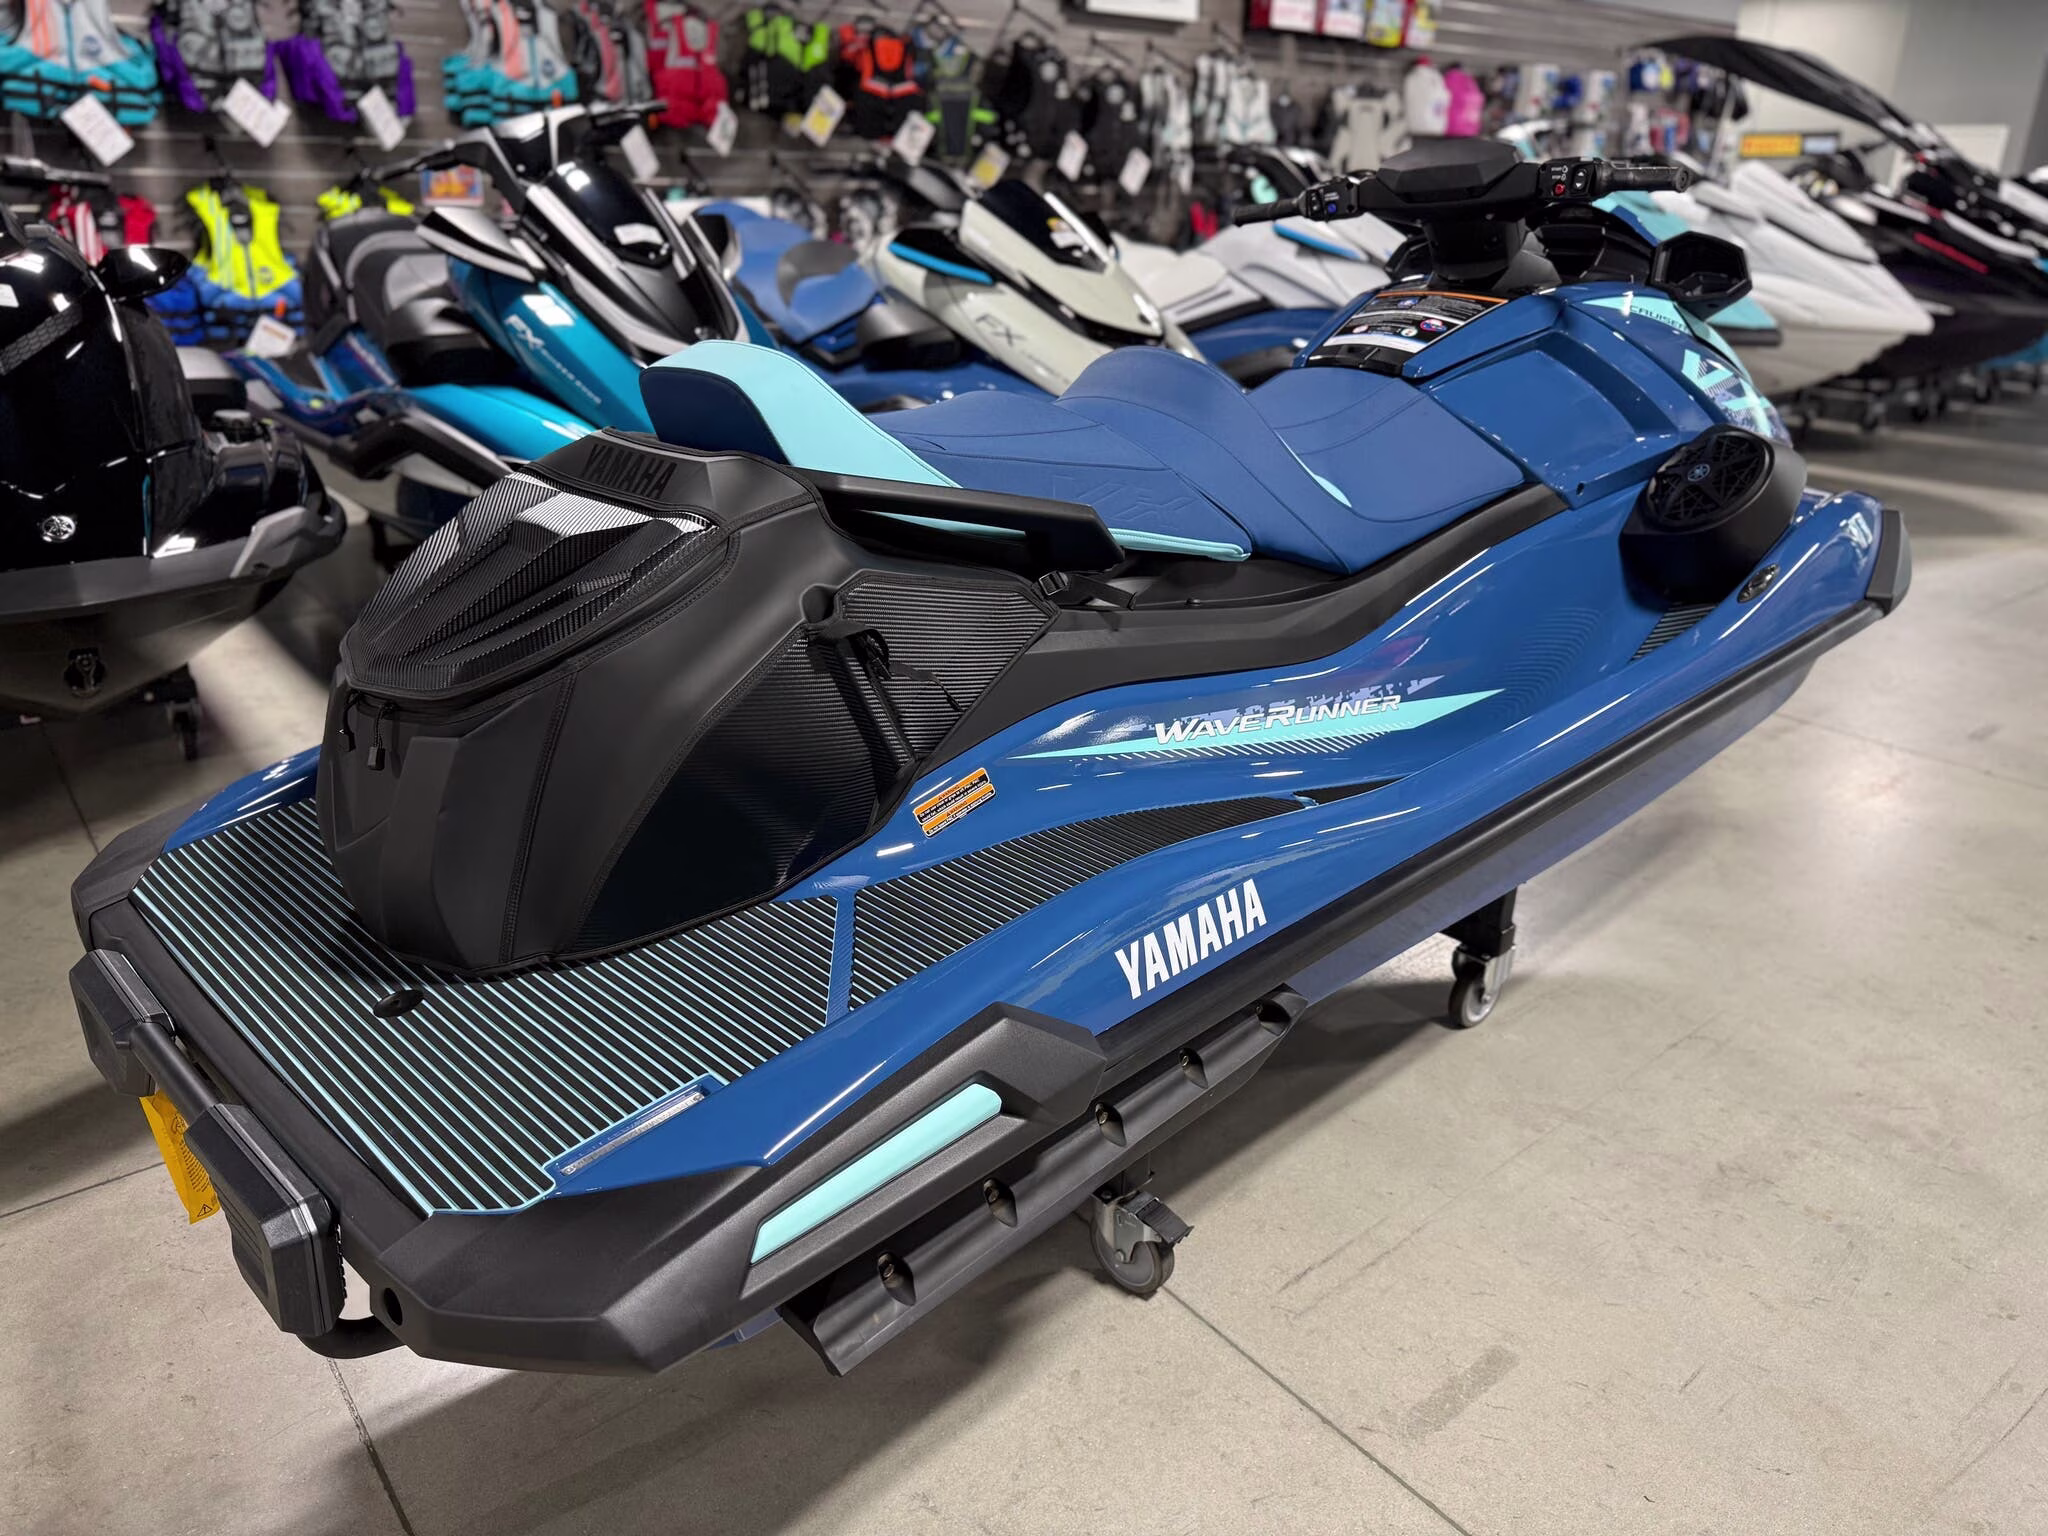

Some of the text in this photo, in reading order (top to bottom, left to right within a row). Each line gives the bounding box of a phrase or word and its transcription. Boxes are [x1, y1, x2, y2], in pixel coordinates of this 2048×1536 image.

[504, 314, 544, 350] FX
[976, 314, 1028, 348] FX
[583, 443, 678, 499] YAMAHA
[1114, 878, 1268, 1001] YAMAHA
